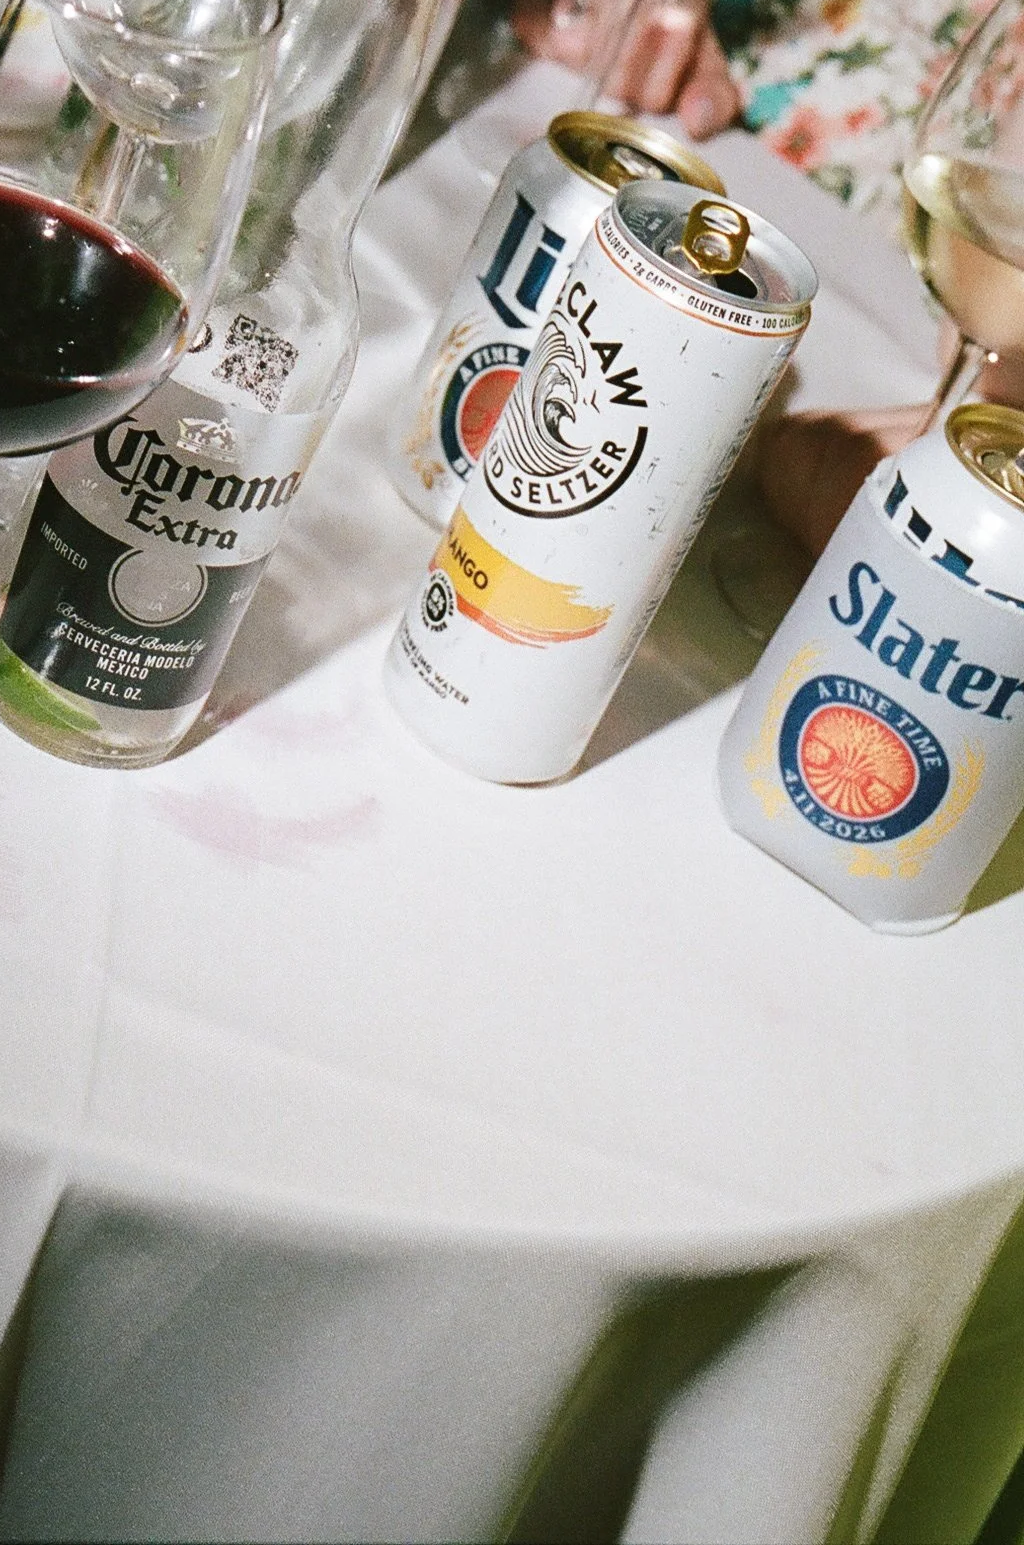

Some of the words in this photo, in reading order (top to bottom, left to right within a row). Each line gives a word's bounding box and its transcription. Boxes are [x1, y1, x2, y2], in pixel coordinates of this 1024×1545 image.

[476, 189, 568, 329] Li
[604, 227, 629, 260] CALORIES
[632, 262, 645, 279] 2g
[687, 294, 727, 320] GLUTEN
[728, 310, 753, 327] FREE
[762, 316, 778, 329] 100
[459, 365, 475, 384] A
[567, 281, 648, 409] CLAW
[93, 415, 302, 515] Corona
[508, 440, 629, 506] SELTZER
[40, 521, 88, 571] IMPORTED
[124, 487, 238, 552] Extra
[446, 532, 489, 590] ANGO
[56, 601, 109, 636] Brewed
[110, 630, 142, 648] and
[140, 633, 192, 655] Bottled
[188, 641, 206, 658] by
[59, 622, 142, 666] CERVECERIA
[144, 655, 195, 670] MODELO
[828, 561, 1024, 723] Slater
[85, 676, 101, 691] 12
[102, 681, 121, 698] FL.
[123, 686, 143, 702] OZ.
[96, 657, 149, 681] MEXICO
[817, 680, 833, 701] A
[834, 681, 890, 718] FINE
[895, 712, 944, 771] TIME
[783, 766, 888, 841] 4.11.2026
